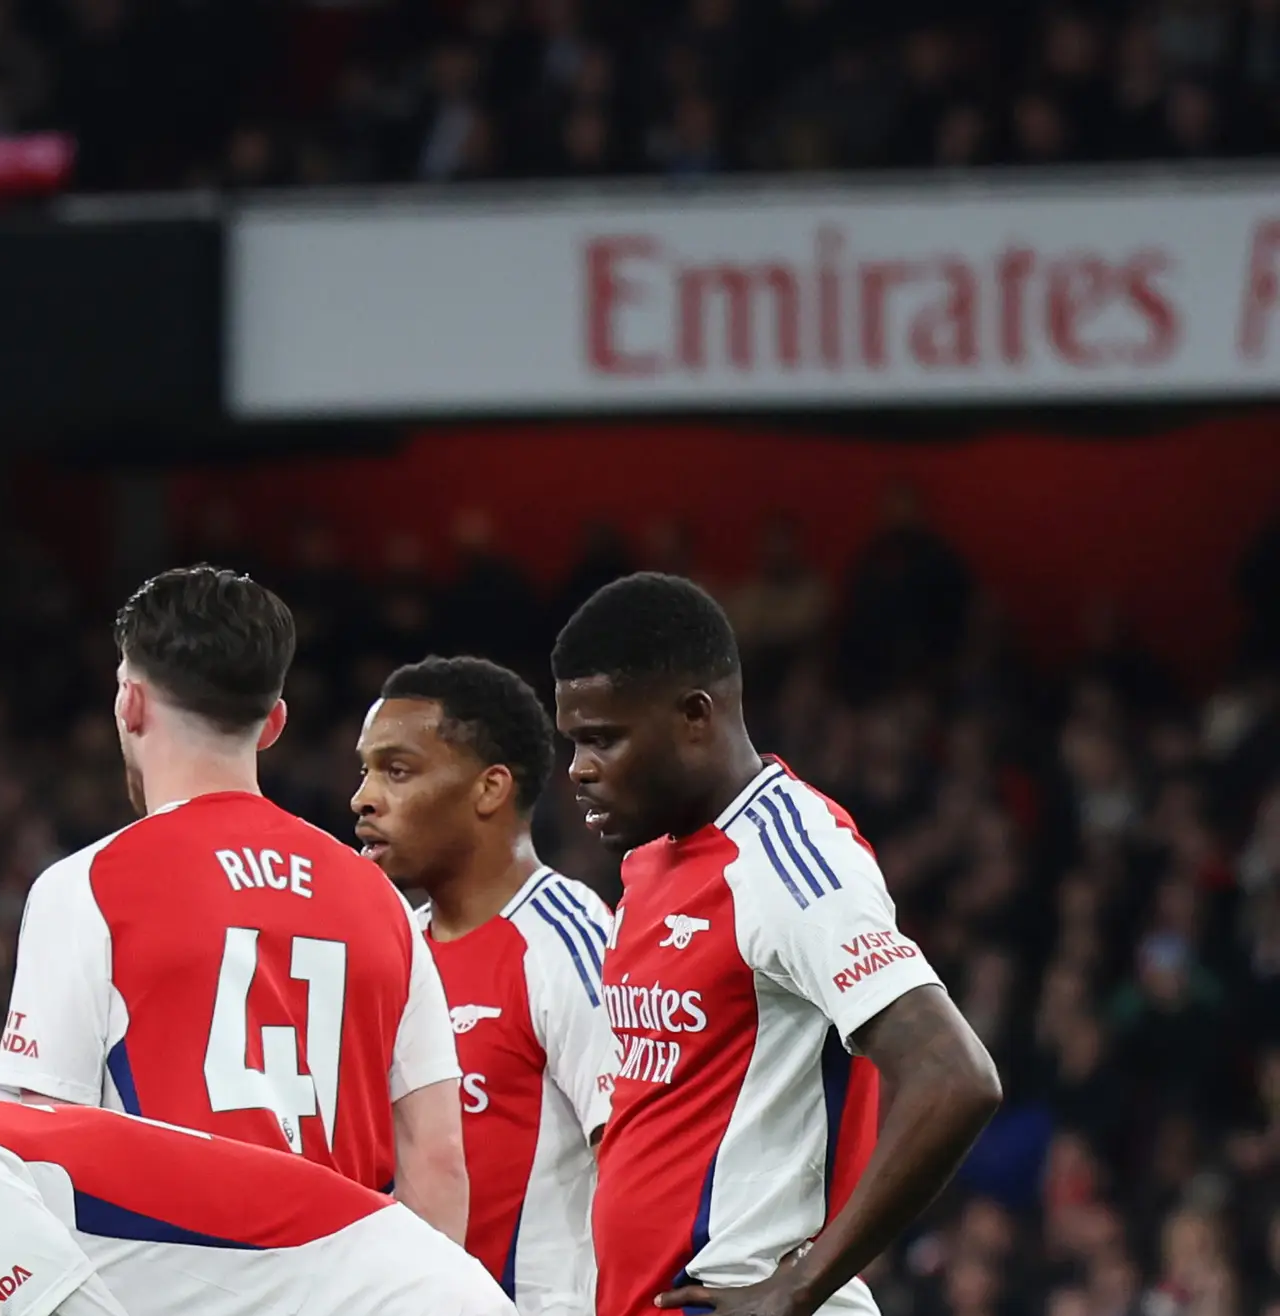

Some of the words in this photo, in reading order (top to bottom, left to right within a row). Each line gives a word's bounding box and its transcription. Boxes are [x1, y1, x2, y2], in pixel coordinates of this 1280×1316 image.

[582, 222, 1182, 378] Emirates
[215, 847, 314, 899] RICE
[832, 945, 918, 993] RWAND
[840, 930, 896, 957] VISIT
[601, 972, 707, 1033] mirates
[203, 926, 348, 1155] 41
